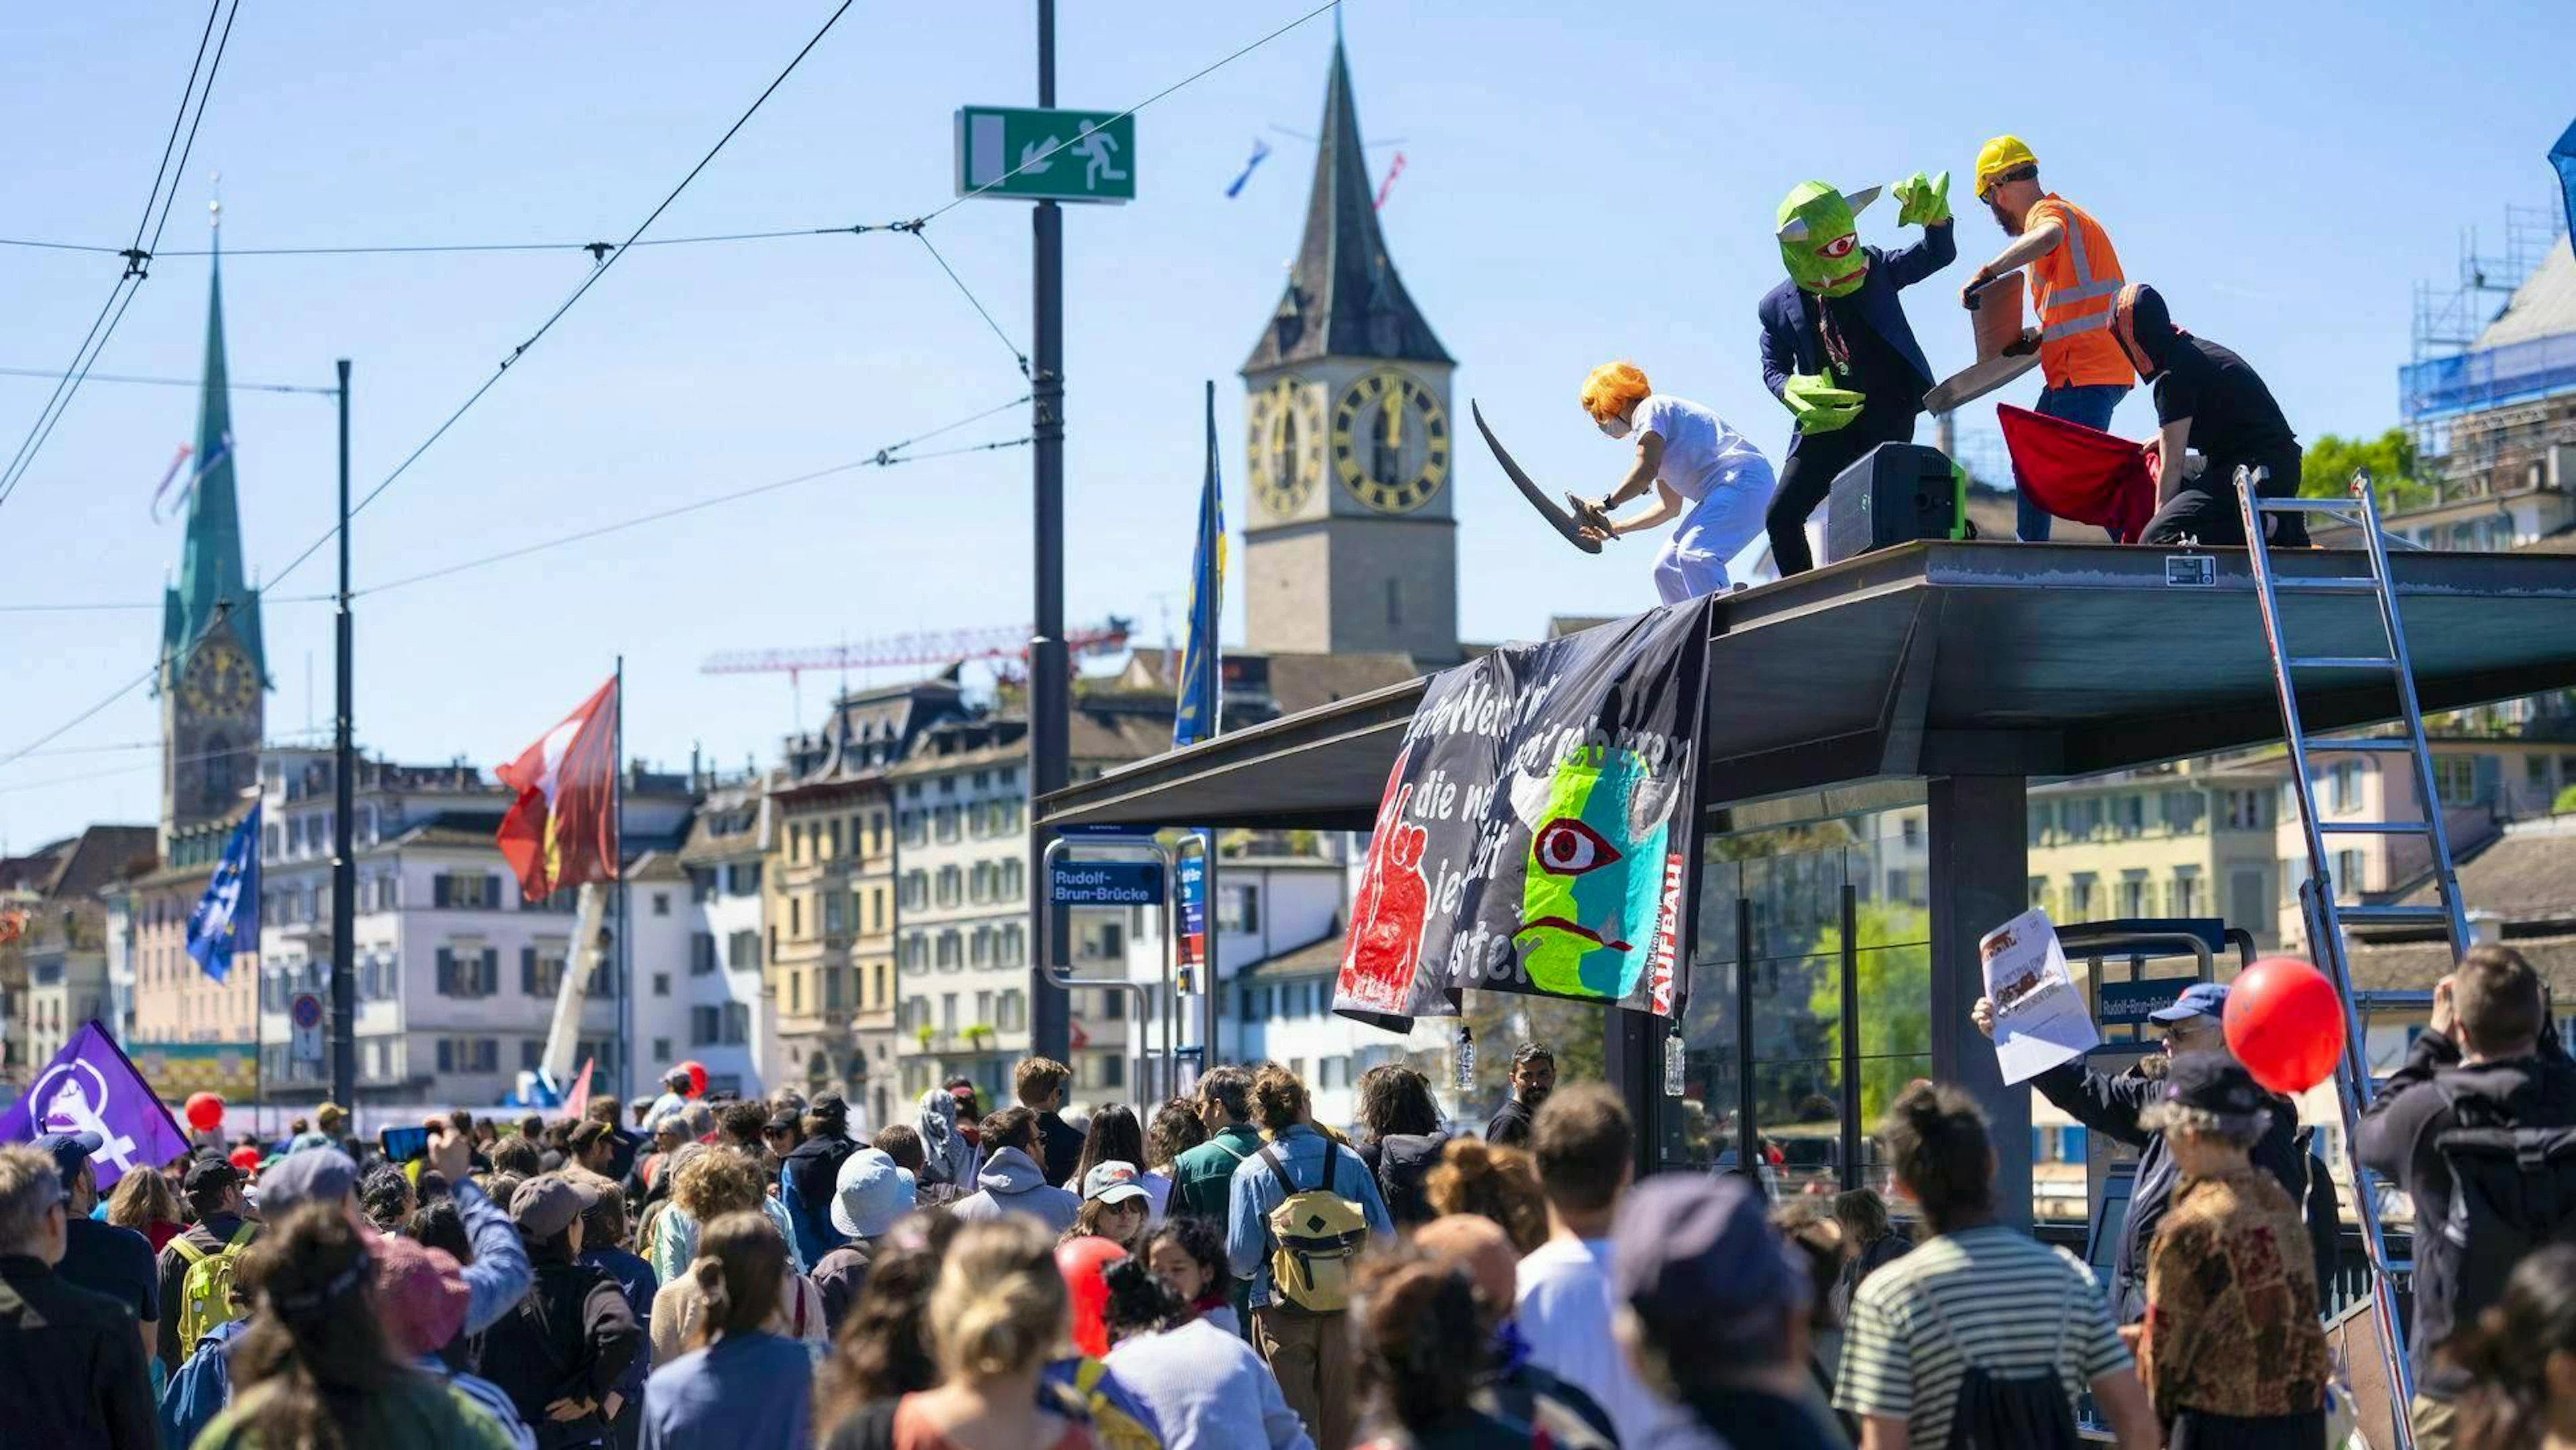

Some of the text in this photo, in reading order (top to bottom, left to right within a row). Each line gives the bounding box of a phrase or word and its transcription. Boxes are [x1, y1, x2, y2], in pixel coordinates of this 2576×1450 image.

[1415, 770, 1457, 820] die
[1055, 871, 1112, 884] Rudolf-
[1055, 887, 1149, 900] Brun-Brücke
[1653, 864, 1682, 1013] AUFBAU
[2104, 996, 2176, 1016] Rudolf-Brun-Brück
